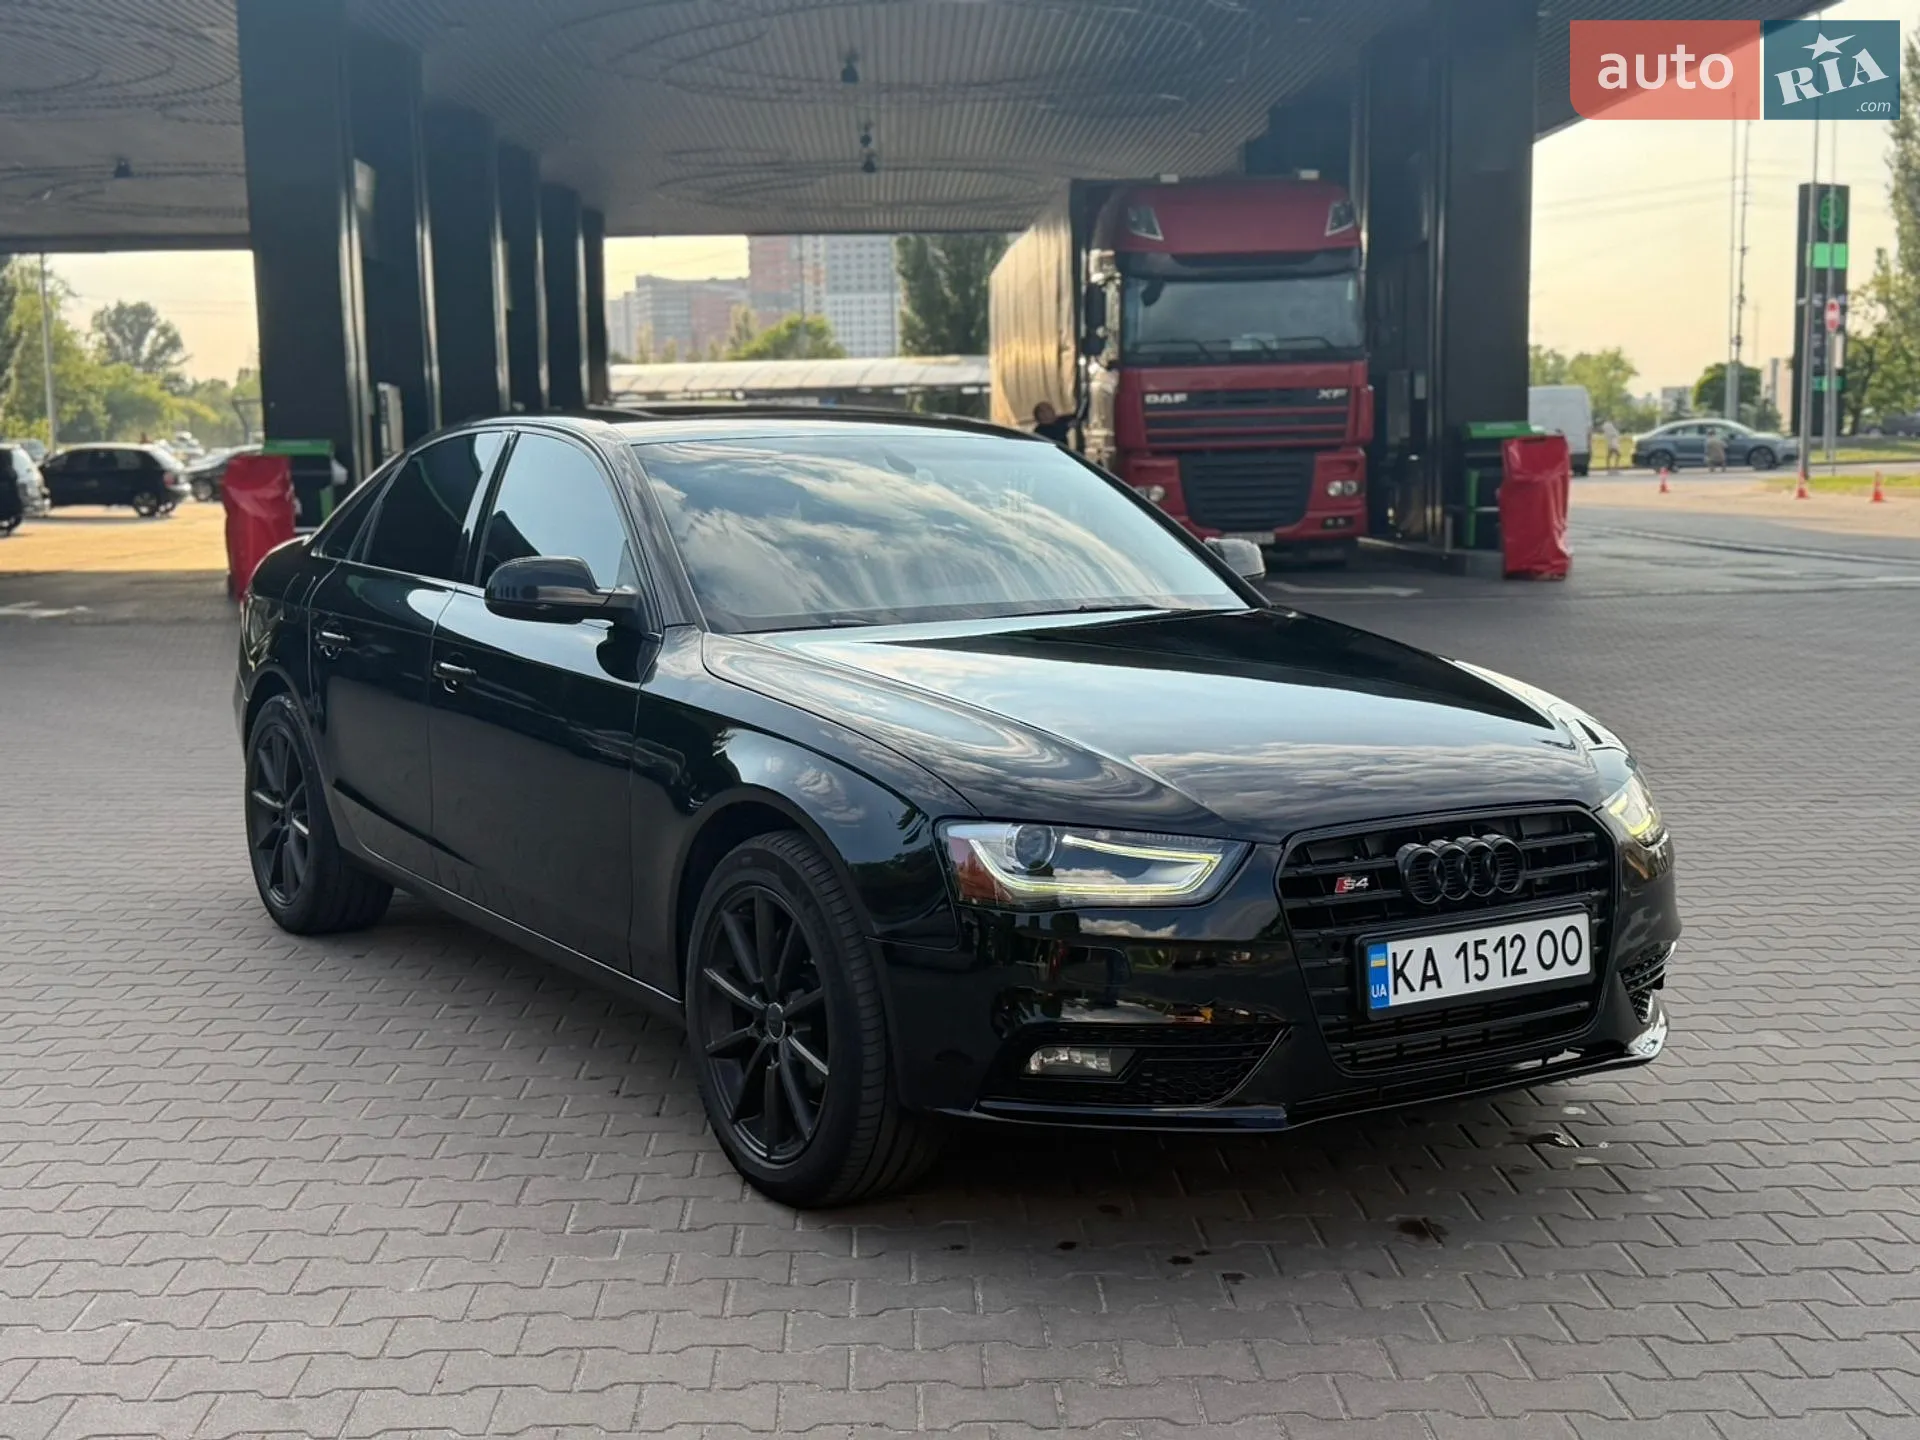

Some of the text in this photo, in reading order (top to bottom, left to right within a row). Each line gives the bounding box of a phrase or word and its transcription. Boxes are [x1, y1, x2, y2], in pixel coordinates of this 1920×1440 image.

[1144, 393, 1188, 405] DAF
[1316, 388, 1348, 400] XF
[1343, 877, 1369, 890] S4
[1391, 946, 1443, 996] KA
[1454, 933, 1528, 984] 1512
[1371, 983, 1388, 999] UA
